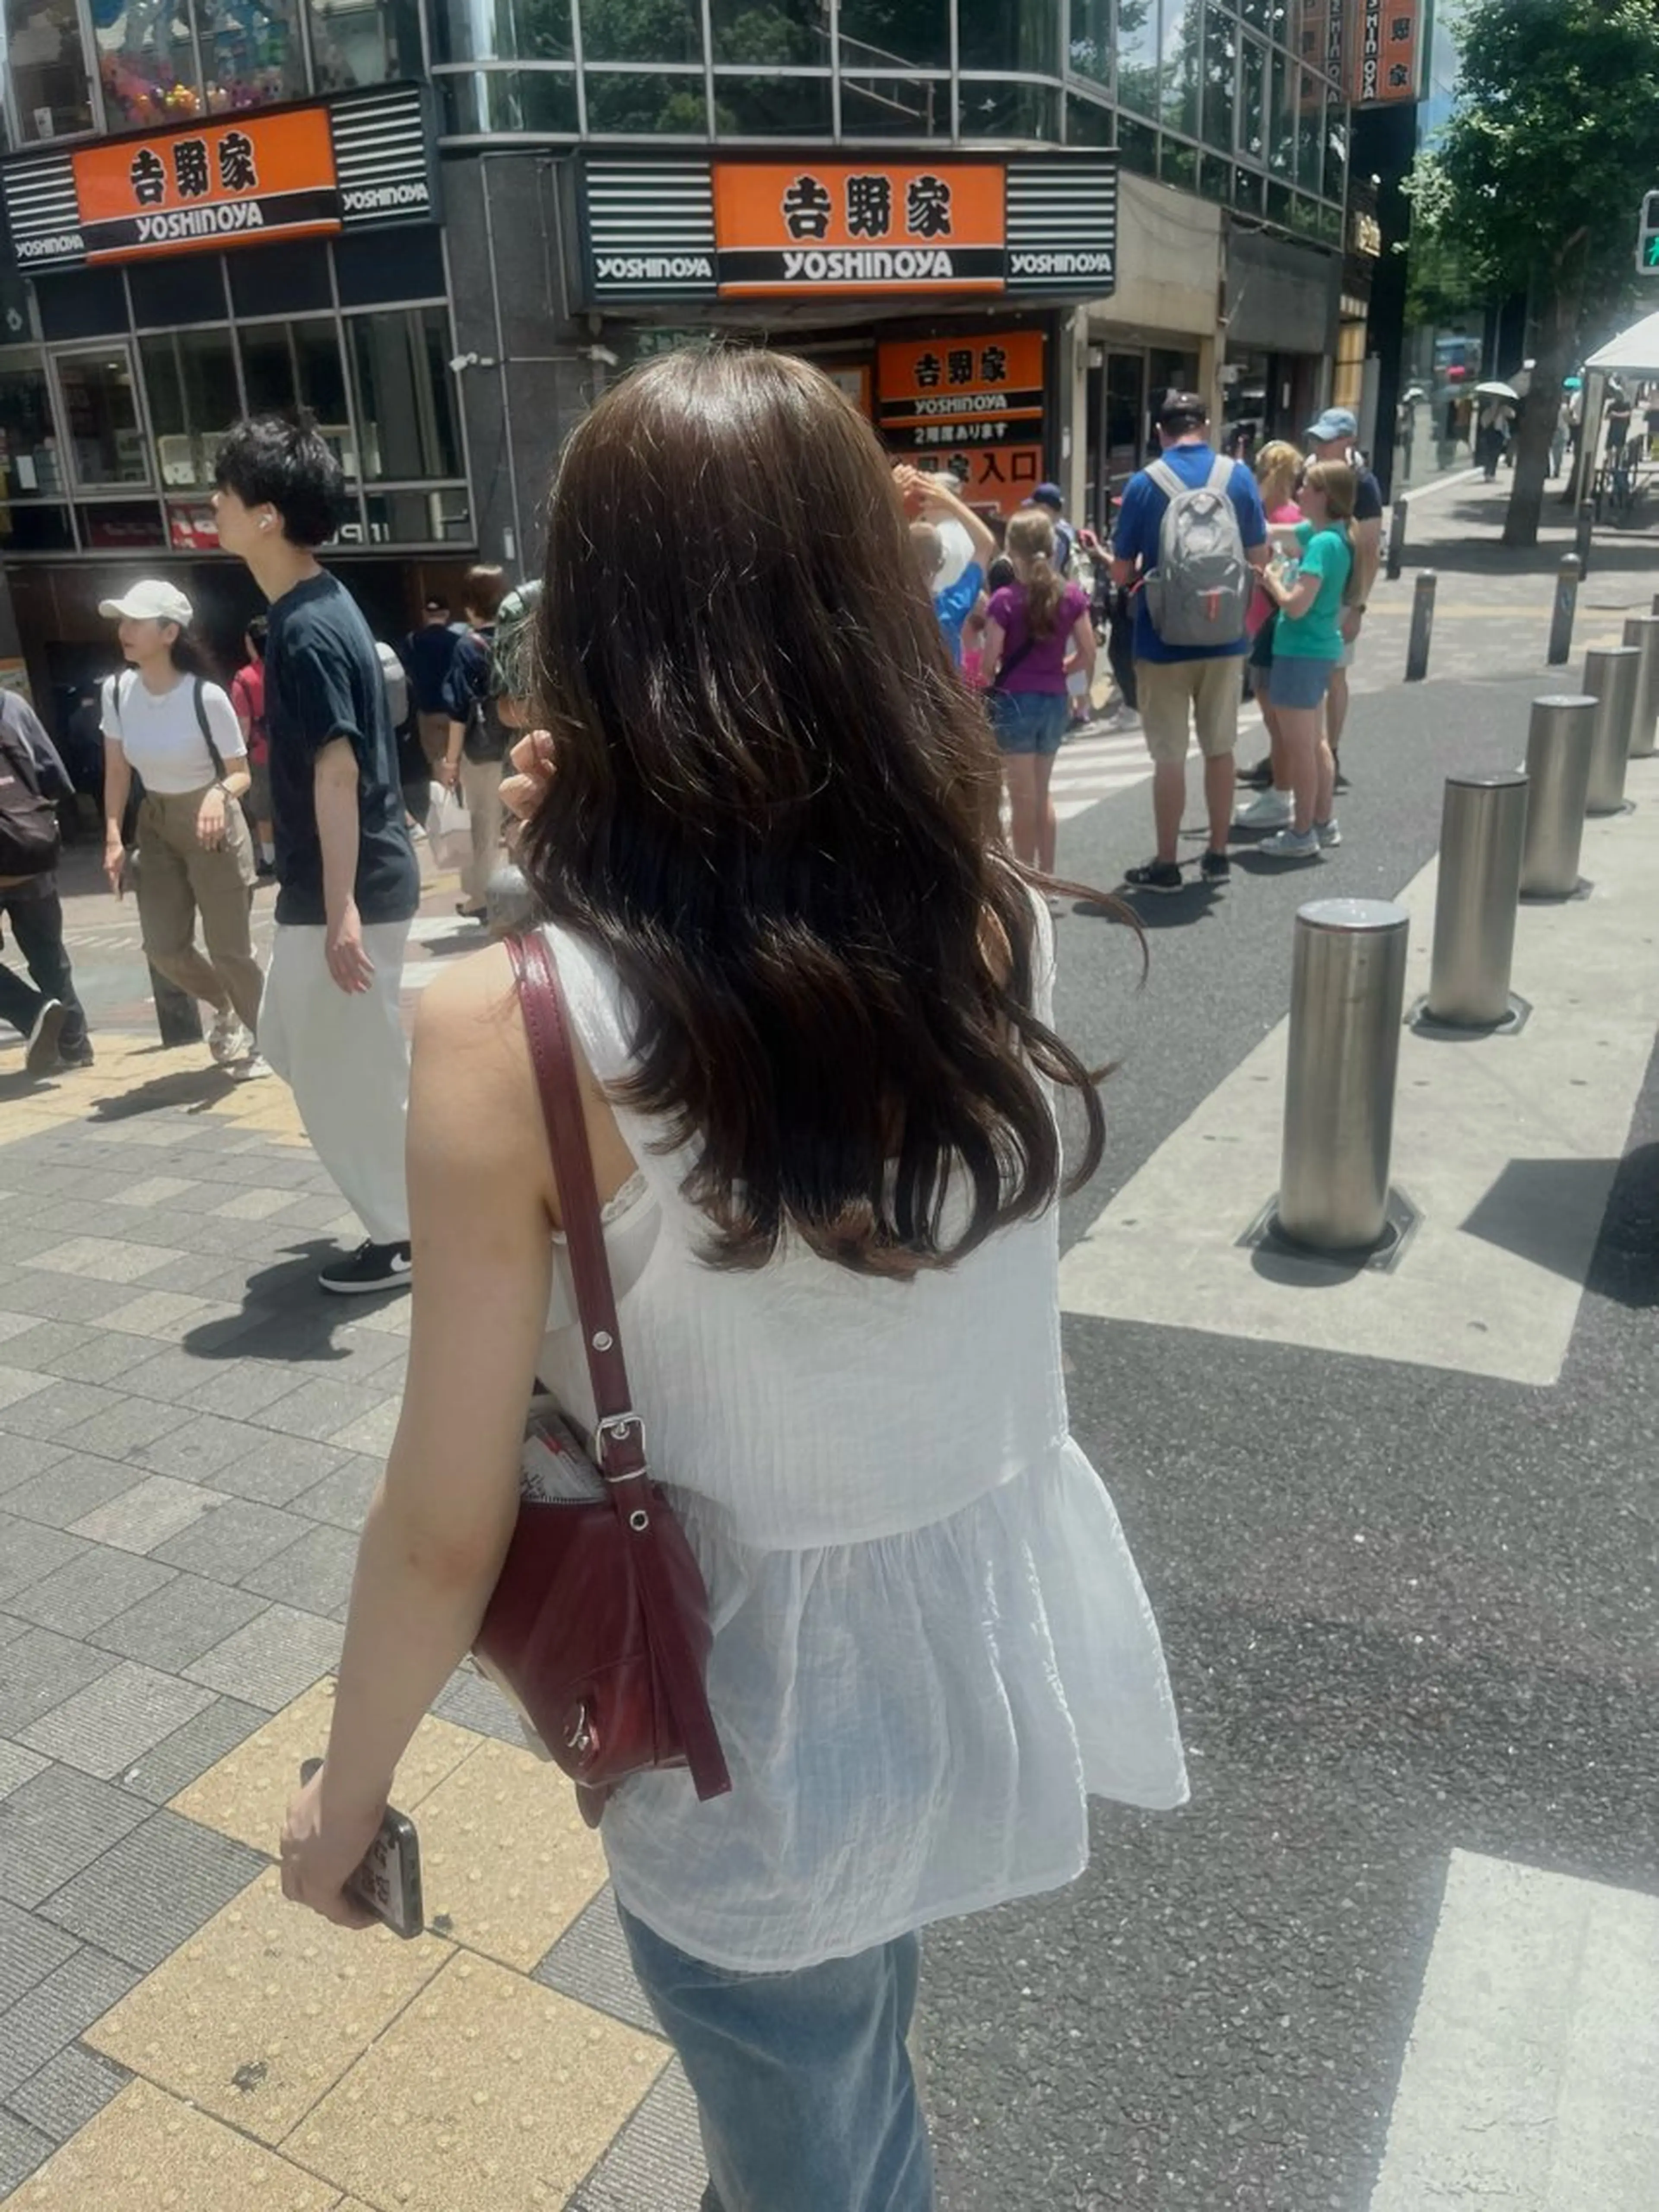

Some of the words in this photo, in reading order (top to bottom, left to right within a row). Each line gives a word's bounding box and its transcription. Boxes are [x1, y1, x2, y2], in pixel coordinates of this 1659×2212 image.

[343, 182, 429, 211] YOSHINOYA
[135, 202, 263, 242] YOSHINOYA
[15, 234, 84, 258] YOSHINOYA
[596, 257, 712, 278] YOSHINOYA
[782, 251, 953, 280] YOSHINOYA
[1010, 252, 1112, 273] YOSHINOYA
[915, 394, 1008, 415] YOSHINOYA
